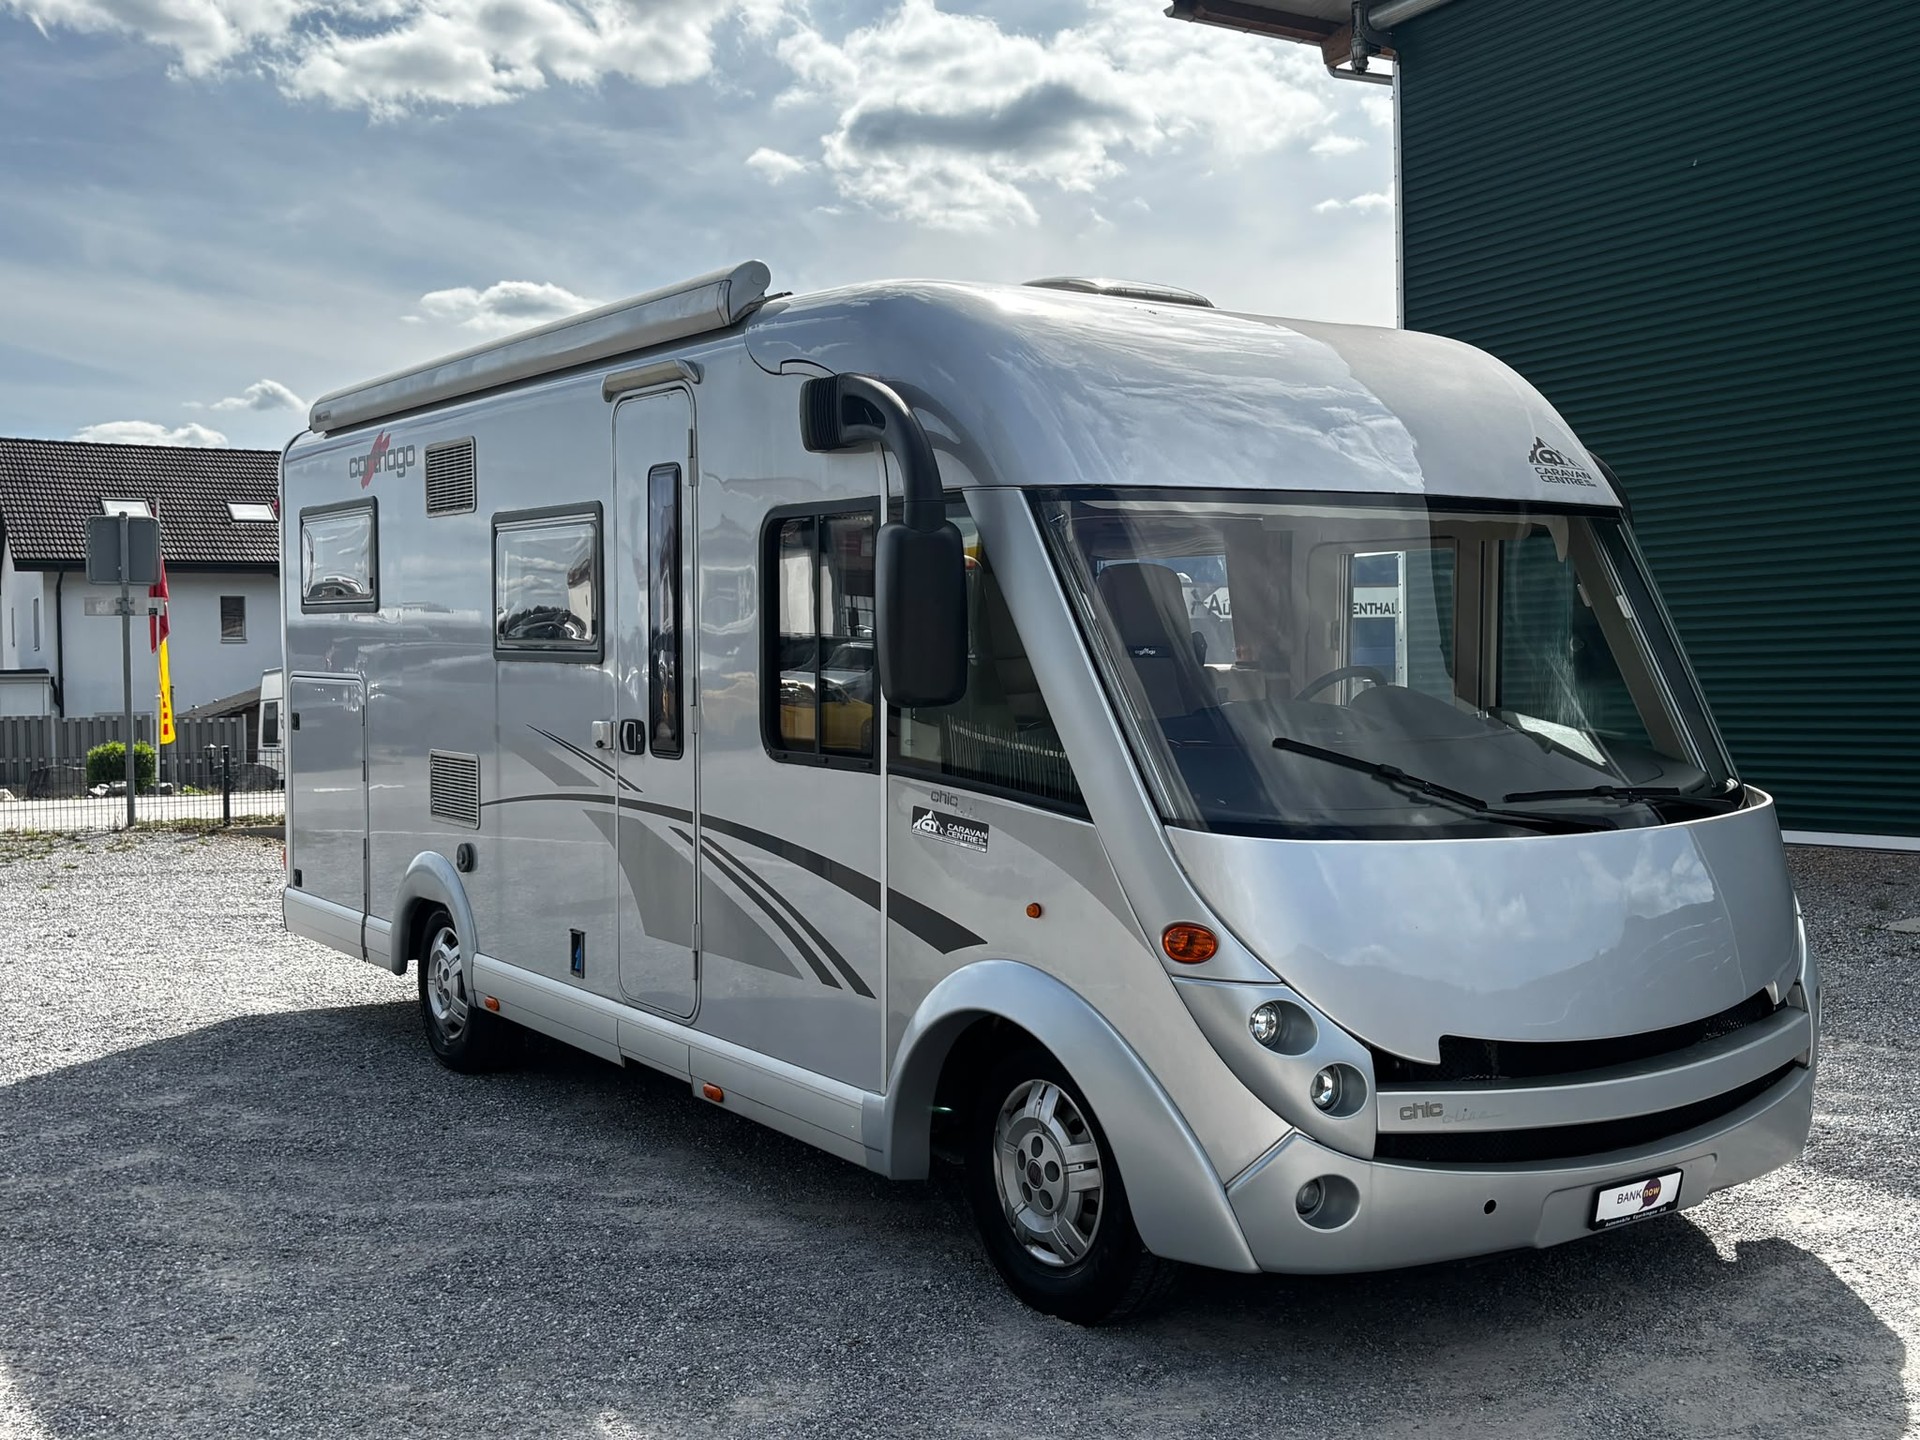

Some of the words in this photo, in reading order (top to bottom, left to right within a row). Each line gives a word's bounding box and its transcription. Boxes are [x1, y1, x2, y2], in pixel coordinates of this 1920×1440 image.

[1534, 466, 1592, 481] CARAVAN
[1540, 475, 1587, 487] CENTRE
[930, 789, 959, 807] chic
[946, 830, 979, 844] CENTRE
[947, 823, 988, 840] CARAVAN
[1400, 1101, 1444, 1121] chic
[1616, 1188, 1643, 1205] BANK
[1643, 1186, 1661, 1197] now
